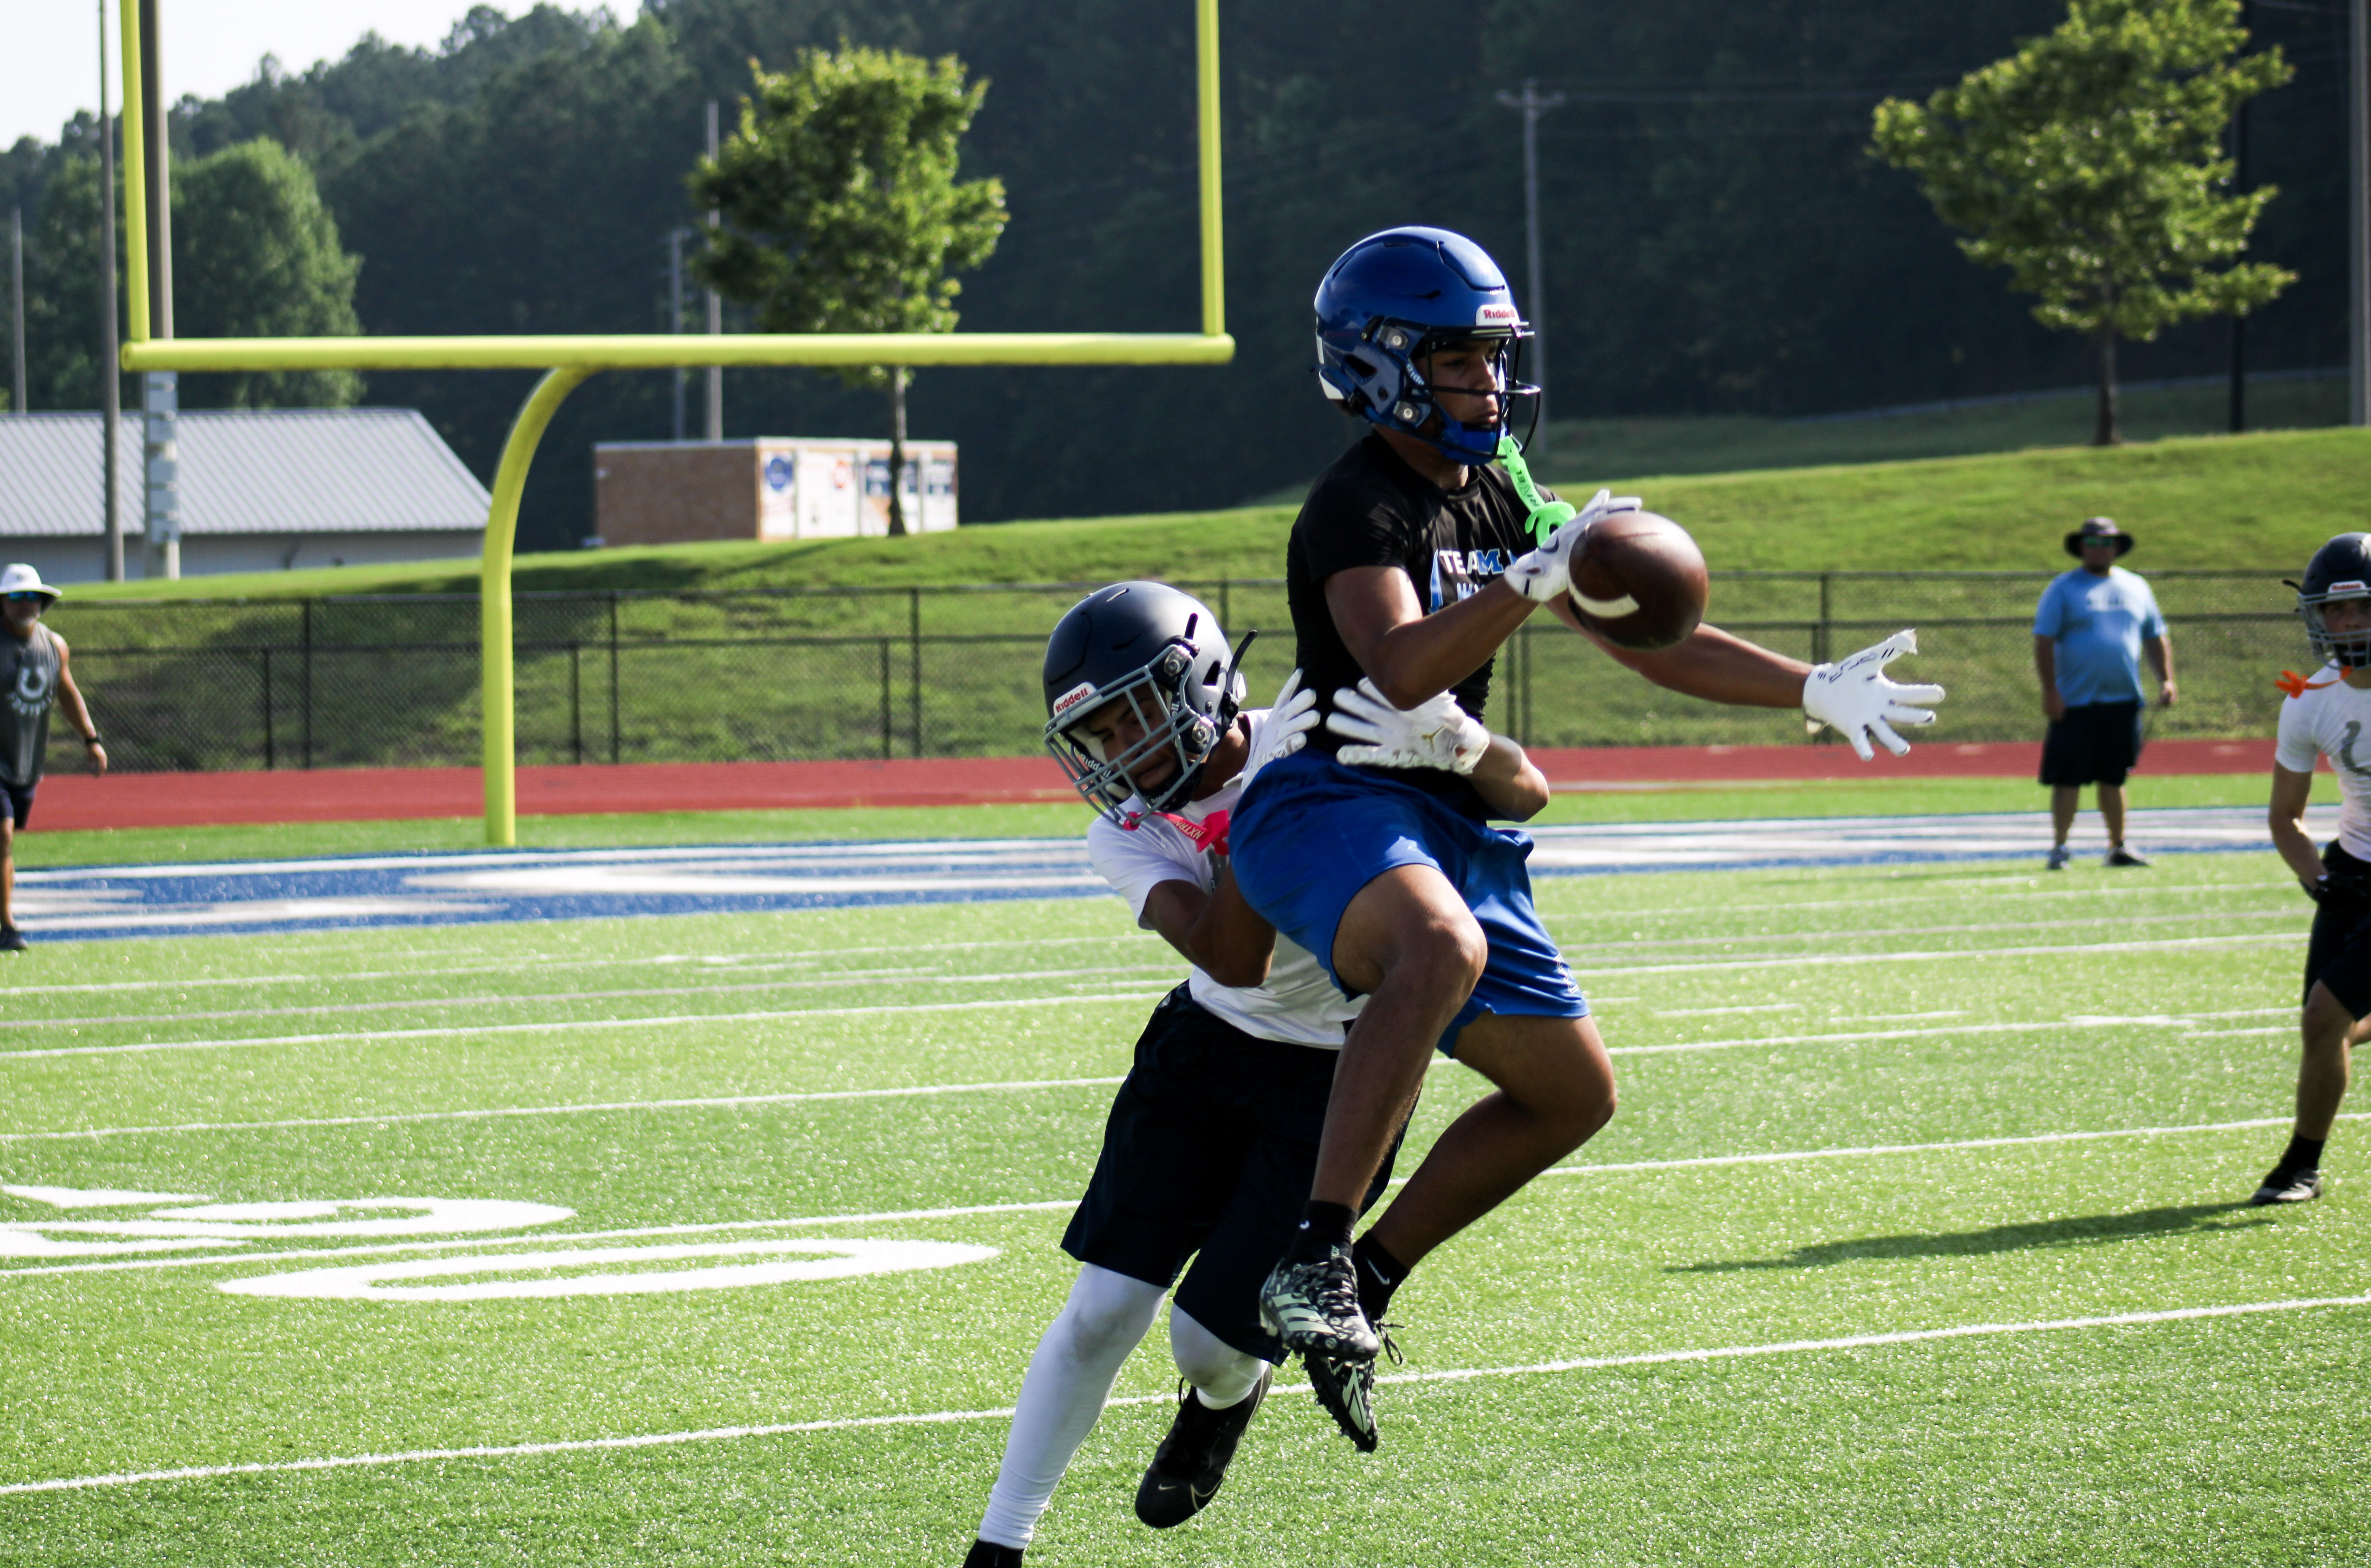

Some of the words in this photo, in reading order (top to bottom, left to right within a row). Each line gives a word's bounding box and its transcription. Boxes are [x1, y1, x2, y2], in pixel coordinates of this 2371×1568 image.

[1484, 309, 1515, 319] Riddell
[1439, 549, 1504, 575] TEAM
[1055, 688, 1088, 713] Riddell
[1081, 753, 1111, 777] Riddll
